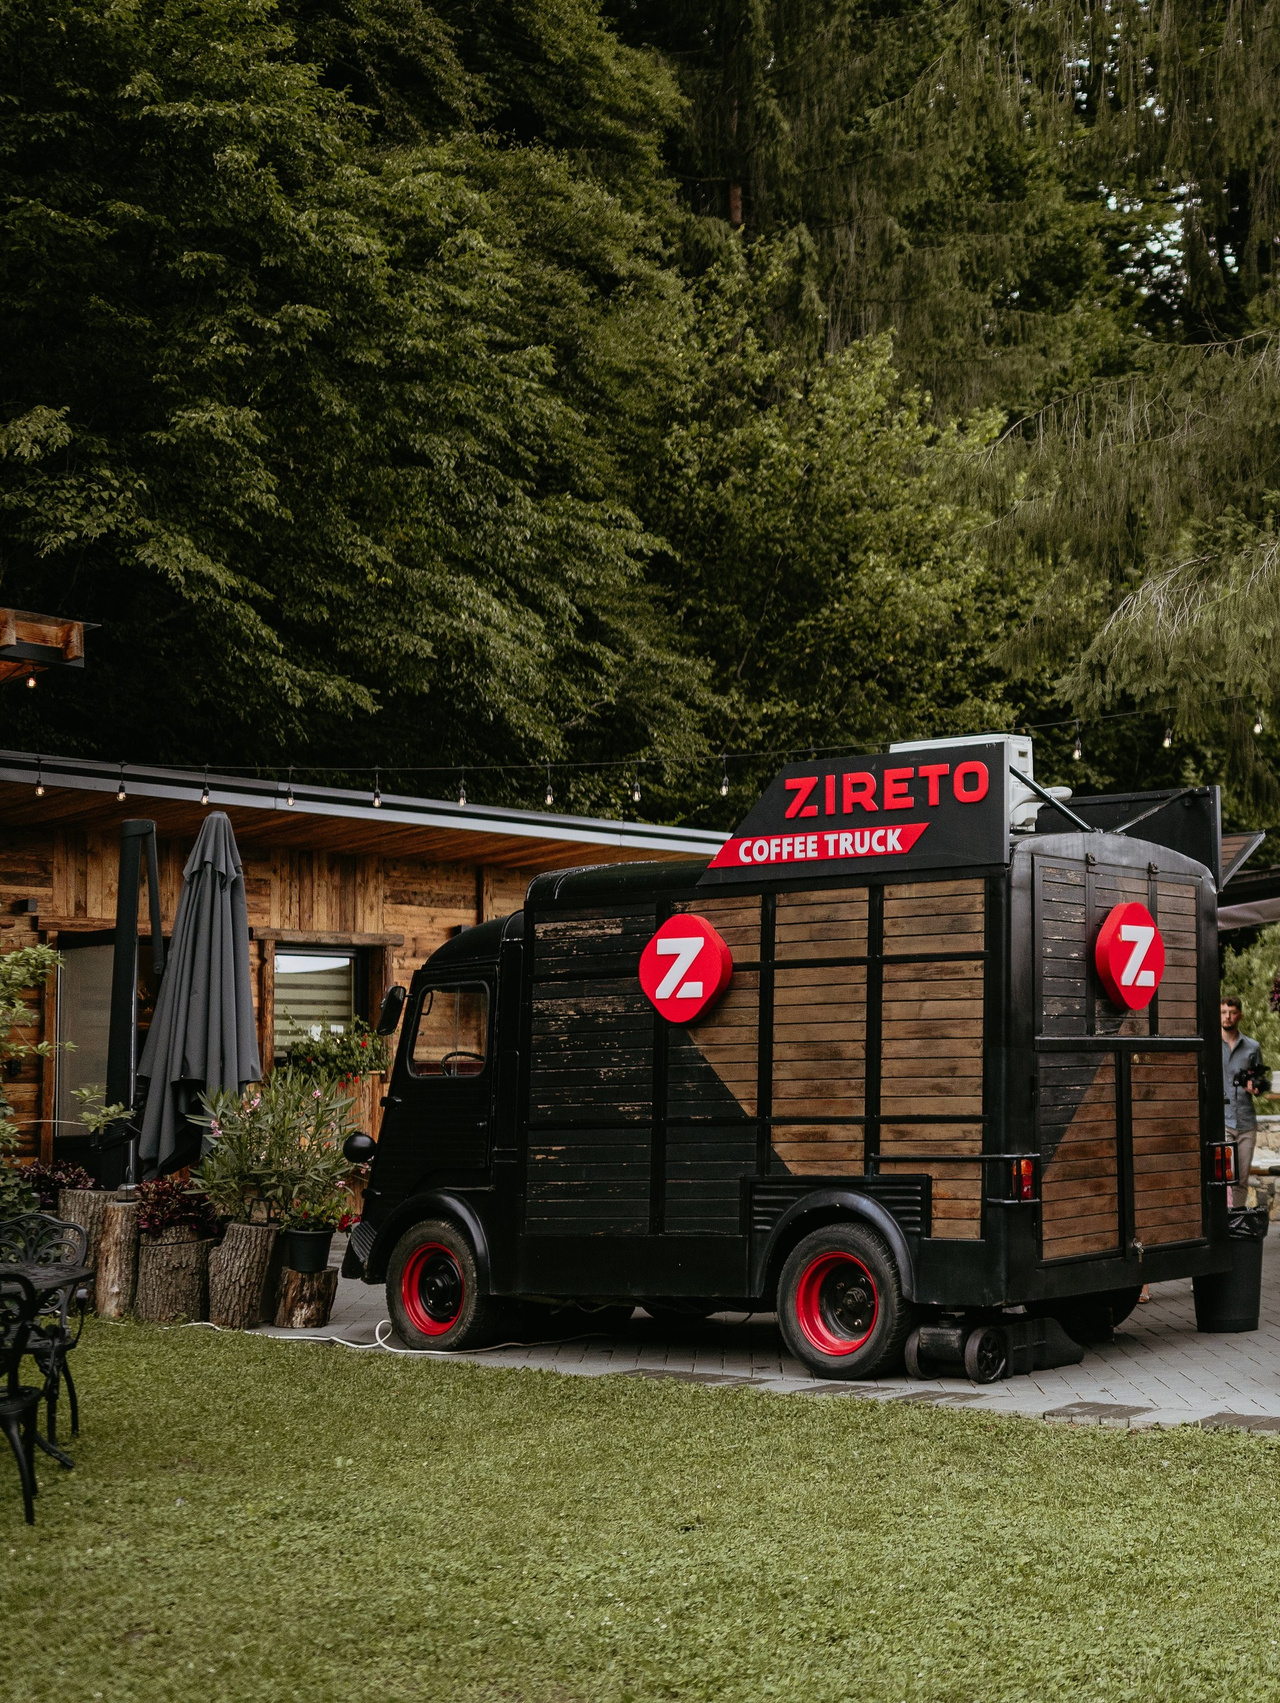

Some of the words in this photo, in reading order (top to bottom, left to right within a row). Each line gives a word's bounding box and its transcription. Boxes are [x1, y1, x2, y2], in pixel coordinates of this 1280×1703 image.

[784, 761, 989, 819] ZIRETO
[738, 834, 819, 863] COFFEE
[824, 827, 904, 857] TRUCK
[655, 937, 704, 999] Z
[1121, 924, 1155, 987] Z
